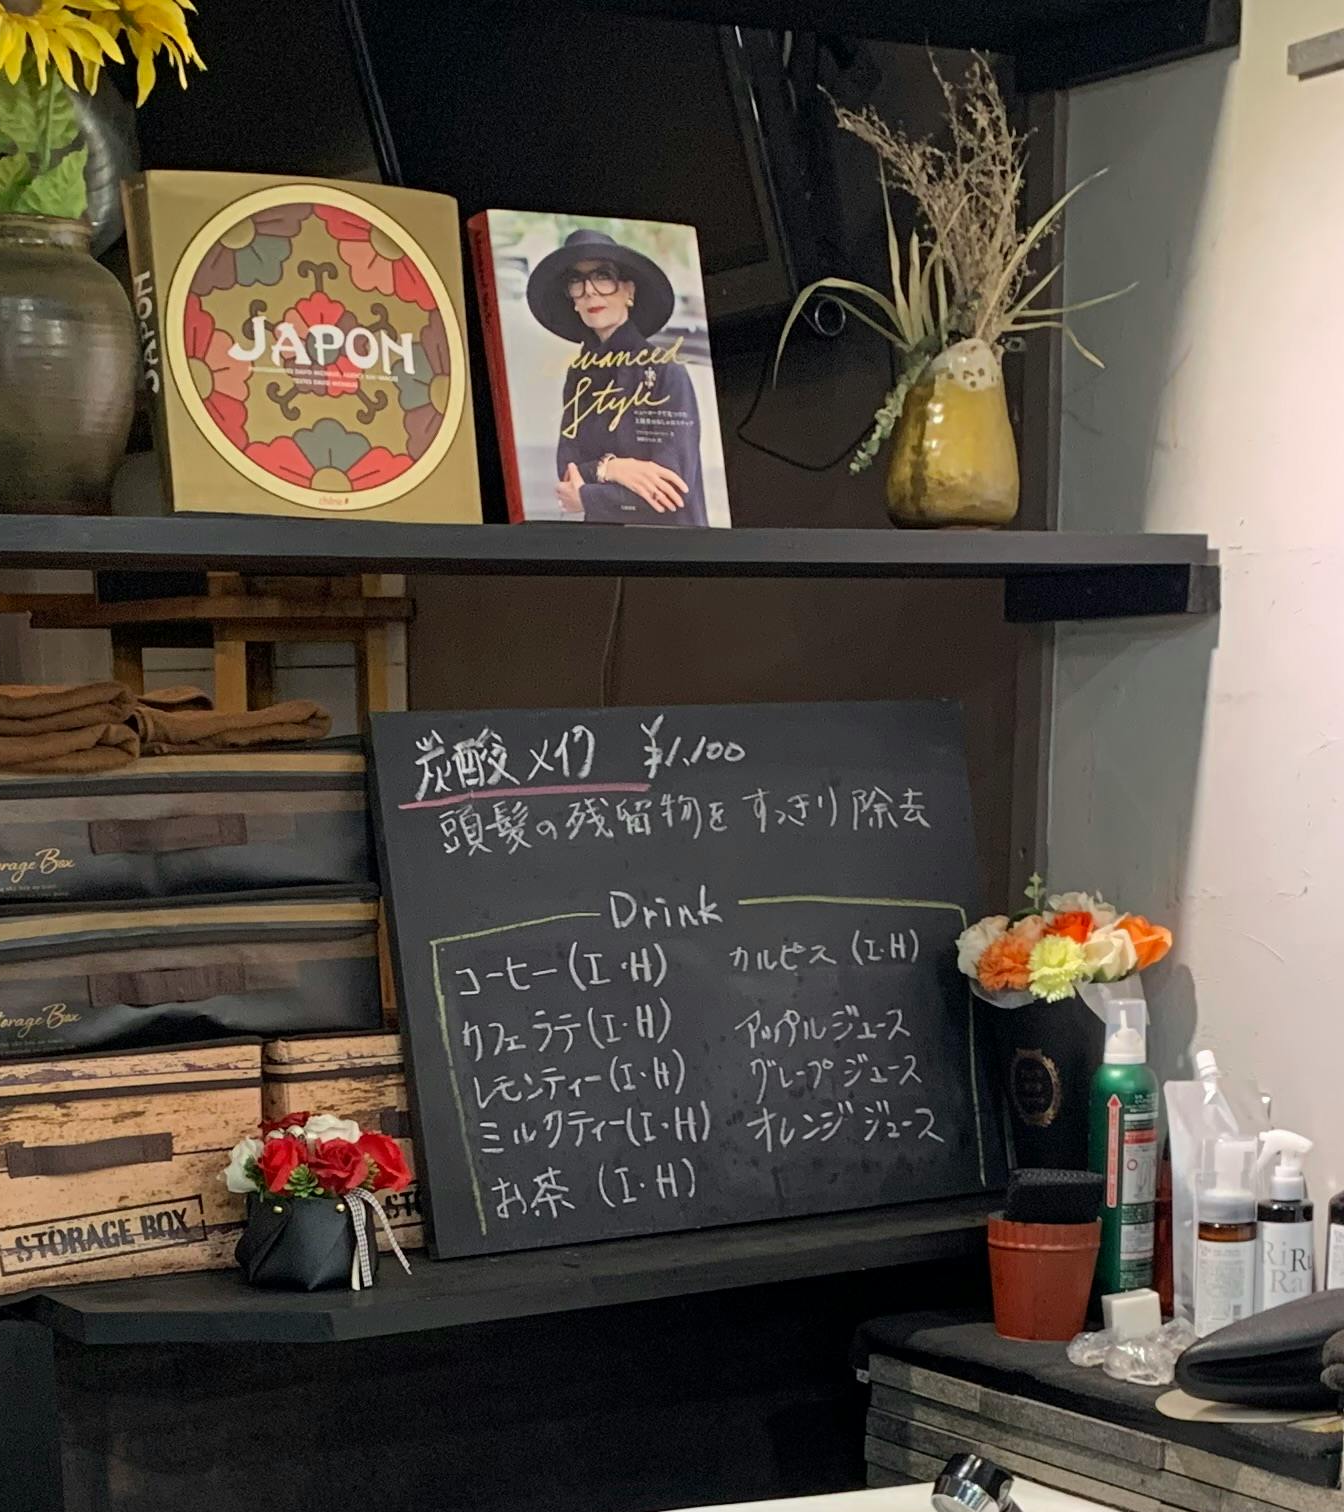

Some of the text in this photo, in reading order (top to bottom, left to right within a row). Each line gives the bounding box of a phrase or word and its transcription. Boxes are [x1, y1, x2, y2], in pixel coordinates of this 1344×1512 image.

[134, 269, 160, 395] JAPON
[227, 316, 415, 375] JAPON
[562, 377, 670, 440] Style
[35, 847, 76, 875] Box
[608, 885, 723, 929] Drink
[42, 1002, 82, 1030] Box
[14, 1207, 191, 1264] STORAGE BOX
[1270, 1269, 1305, 1294] Ra
